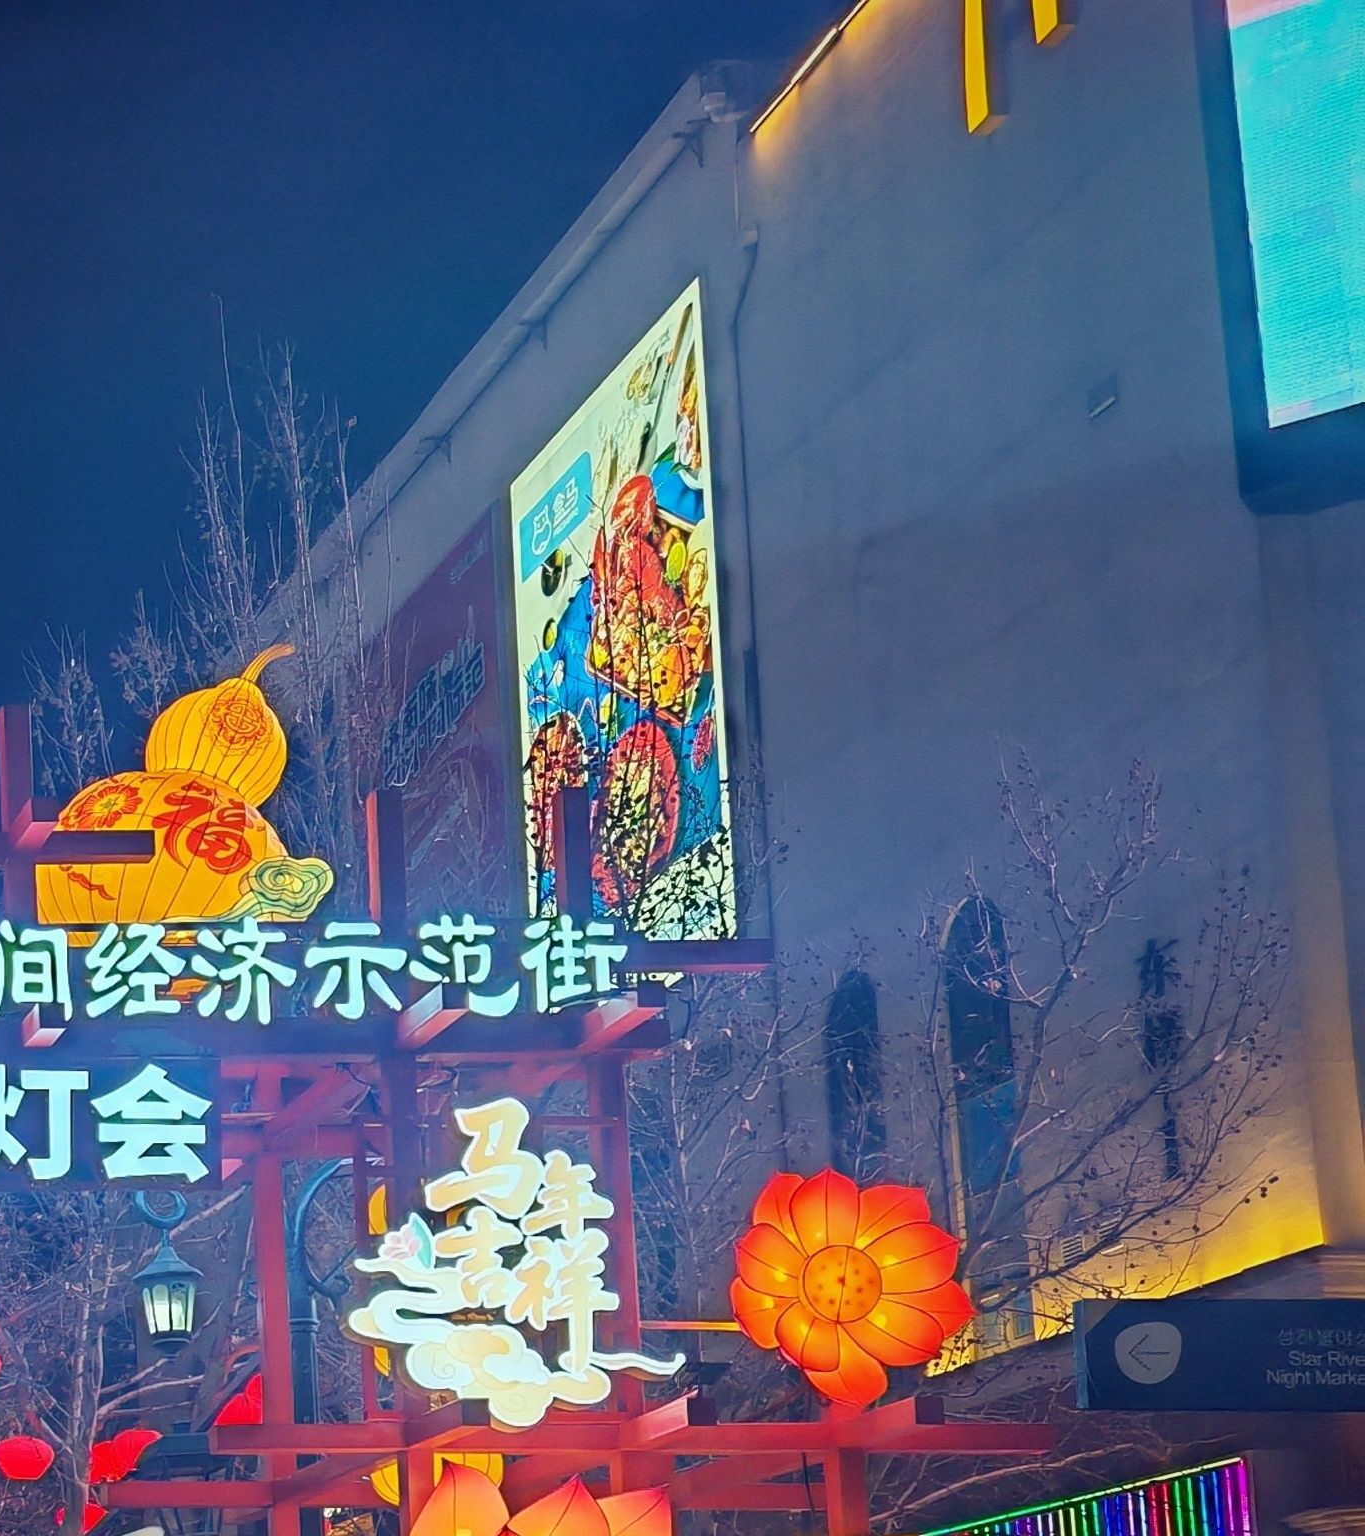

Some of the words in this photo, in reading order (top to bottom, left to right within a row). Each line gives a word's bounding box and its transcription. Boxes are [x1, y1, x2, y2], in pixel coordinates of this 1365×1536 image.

[152, 780, 252, 874] 福
[1289, 1350, 1322, 1367] Star
[1327, 1350, 1365, 1367] Rive
[1266, 1369, 1310, 1389] Night
[1315, 1369, 1365, 1386] Marke
